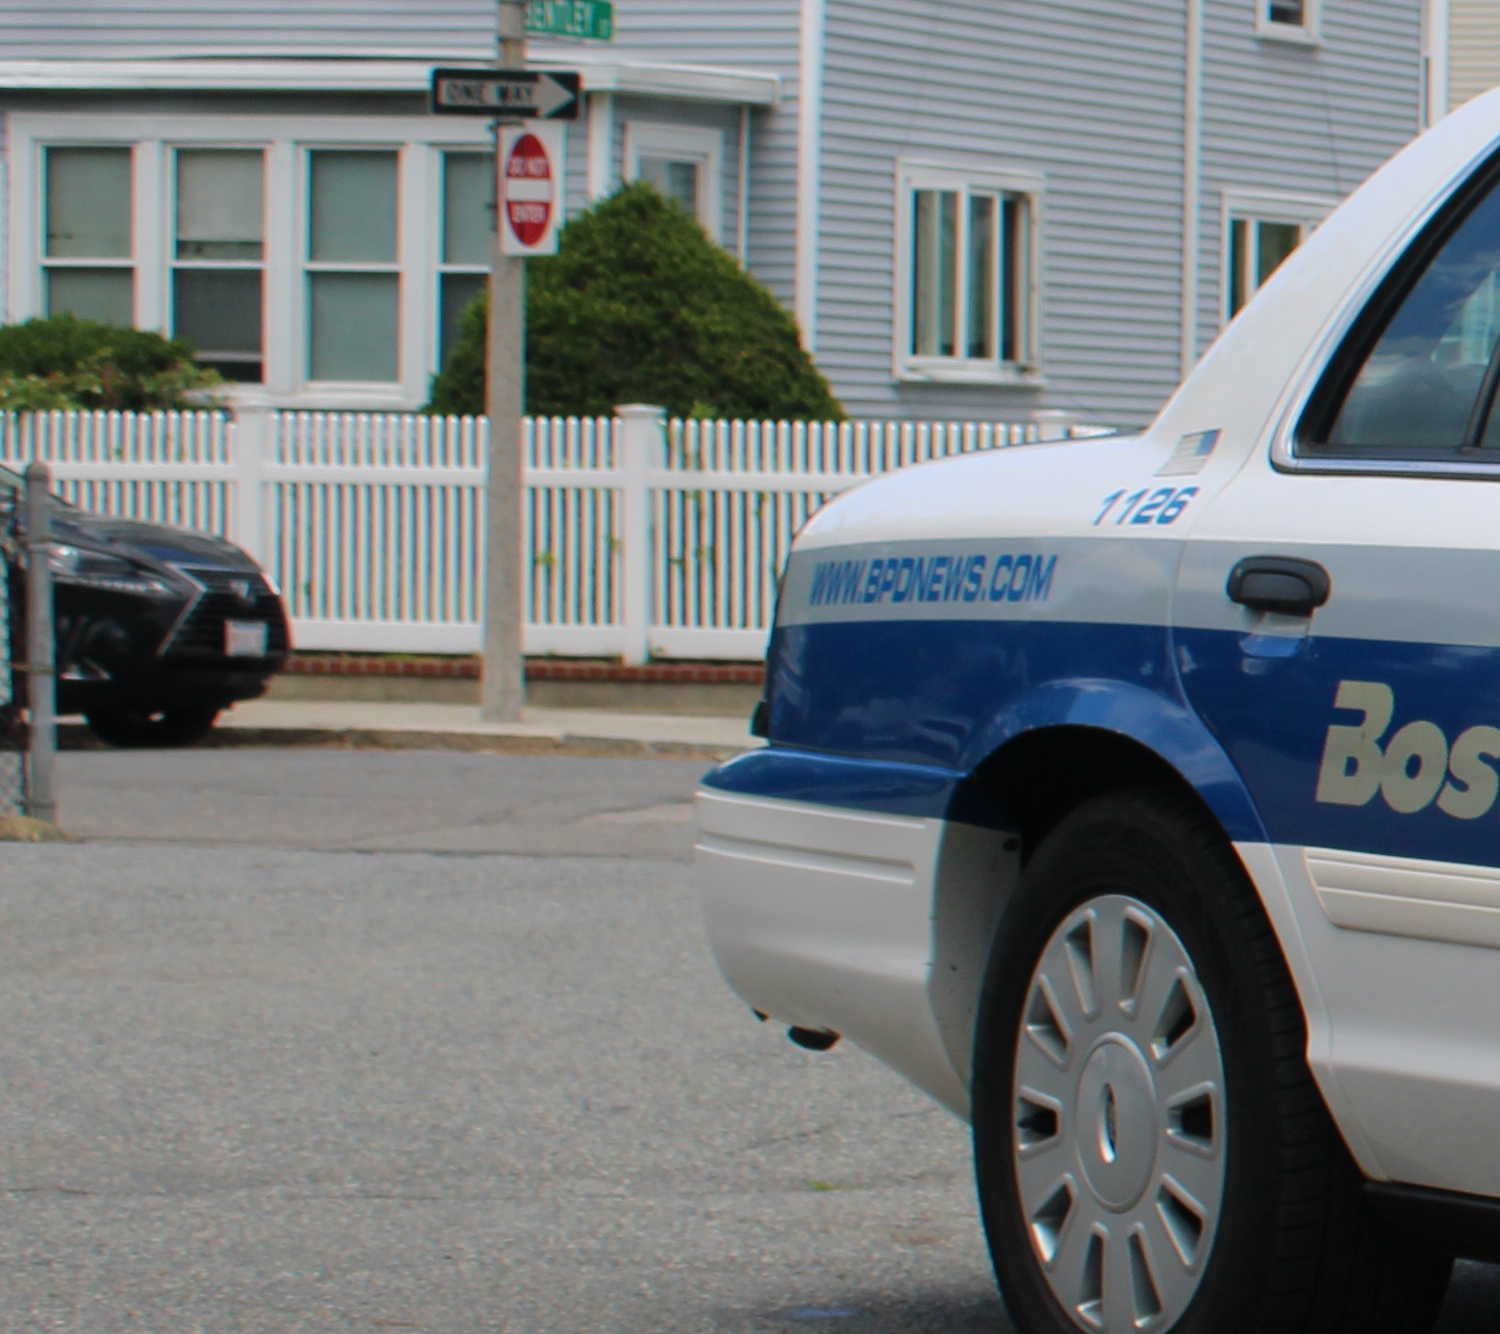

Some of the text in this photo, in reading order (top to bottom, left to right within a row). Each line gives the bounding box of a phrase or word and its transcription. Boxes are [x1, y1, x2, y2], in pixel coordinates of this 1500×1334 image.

[446, 81, 532, 103] ONE WAY
[1092, 486, 1199, 526] 1126
[809, 554, 1058, 605] WWW.BPDNEWS.COM
